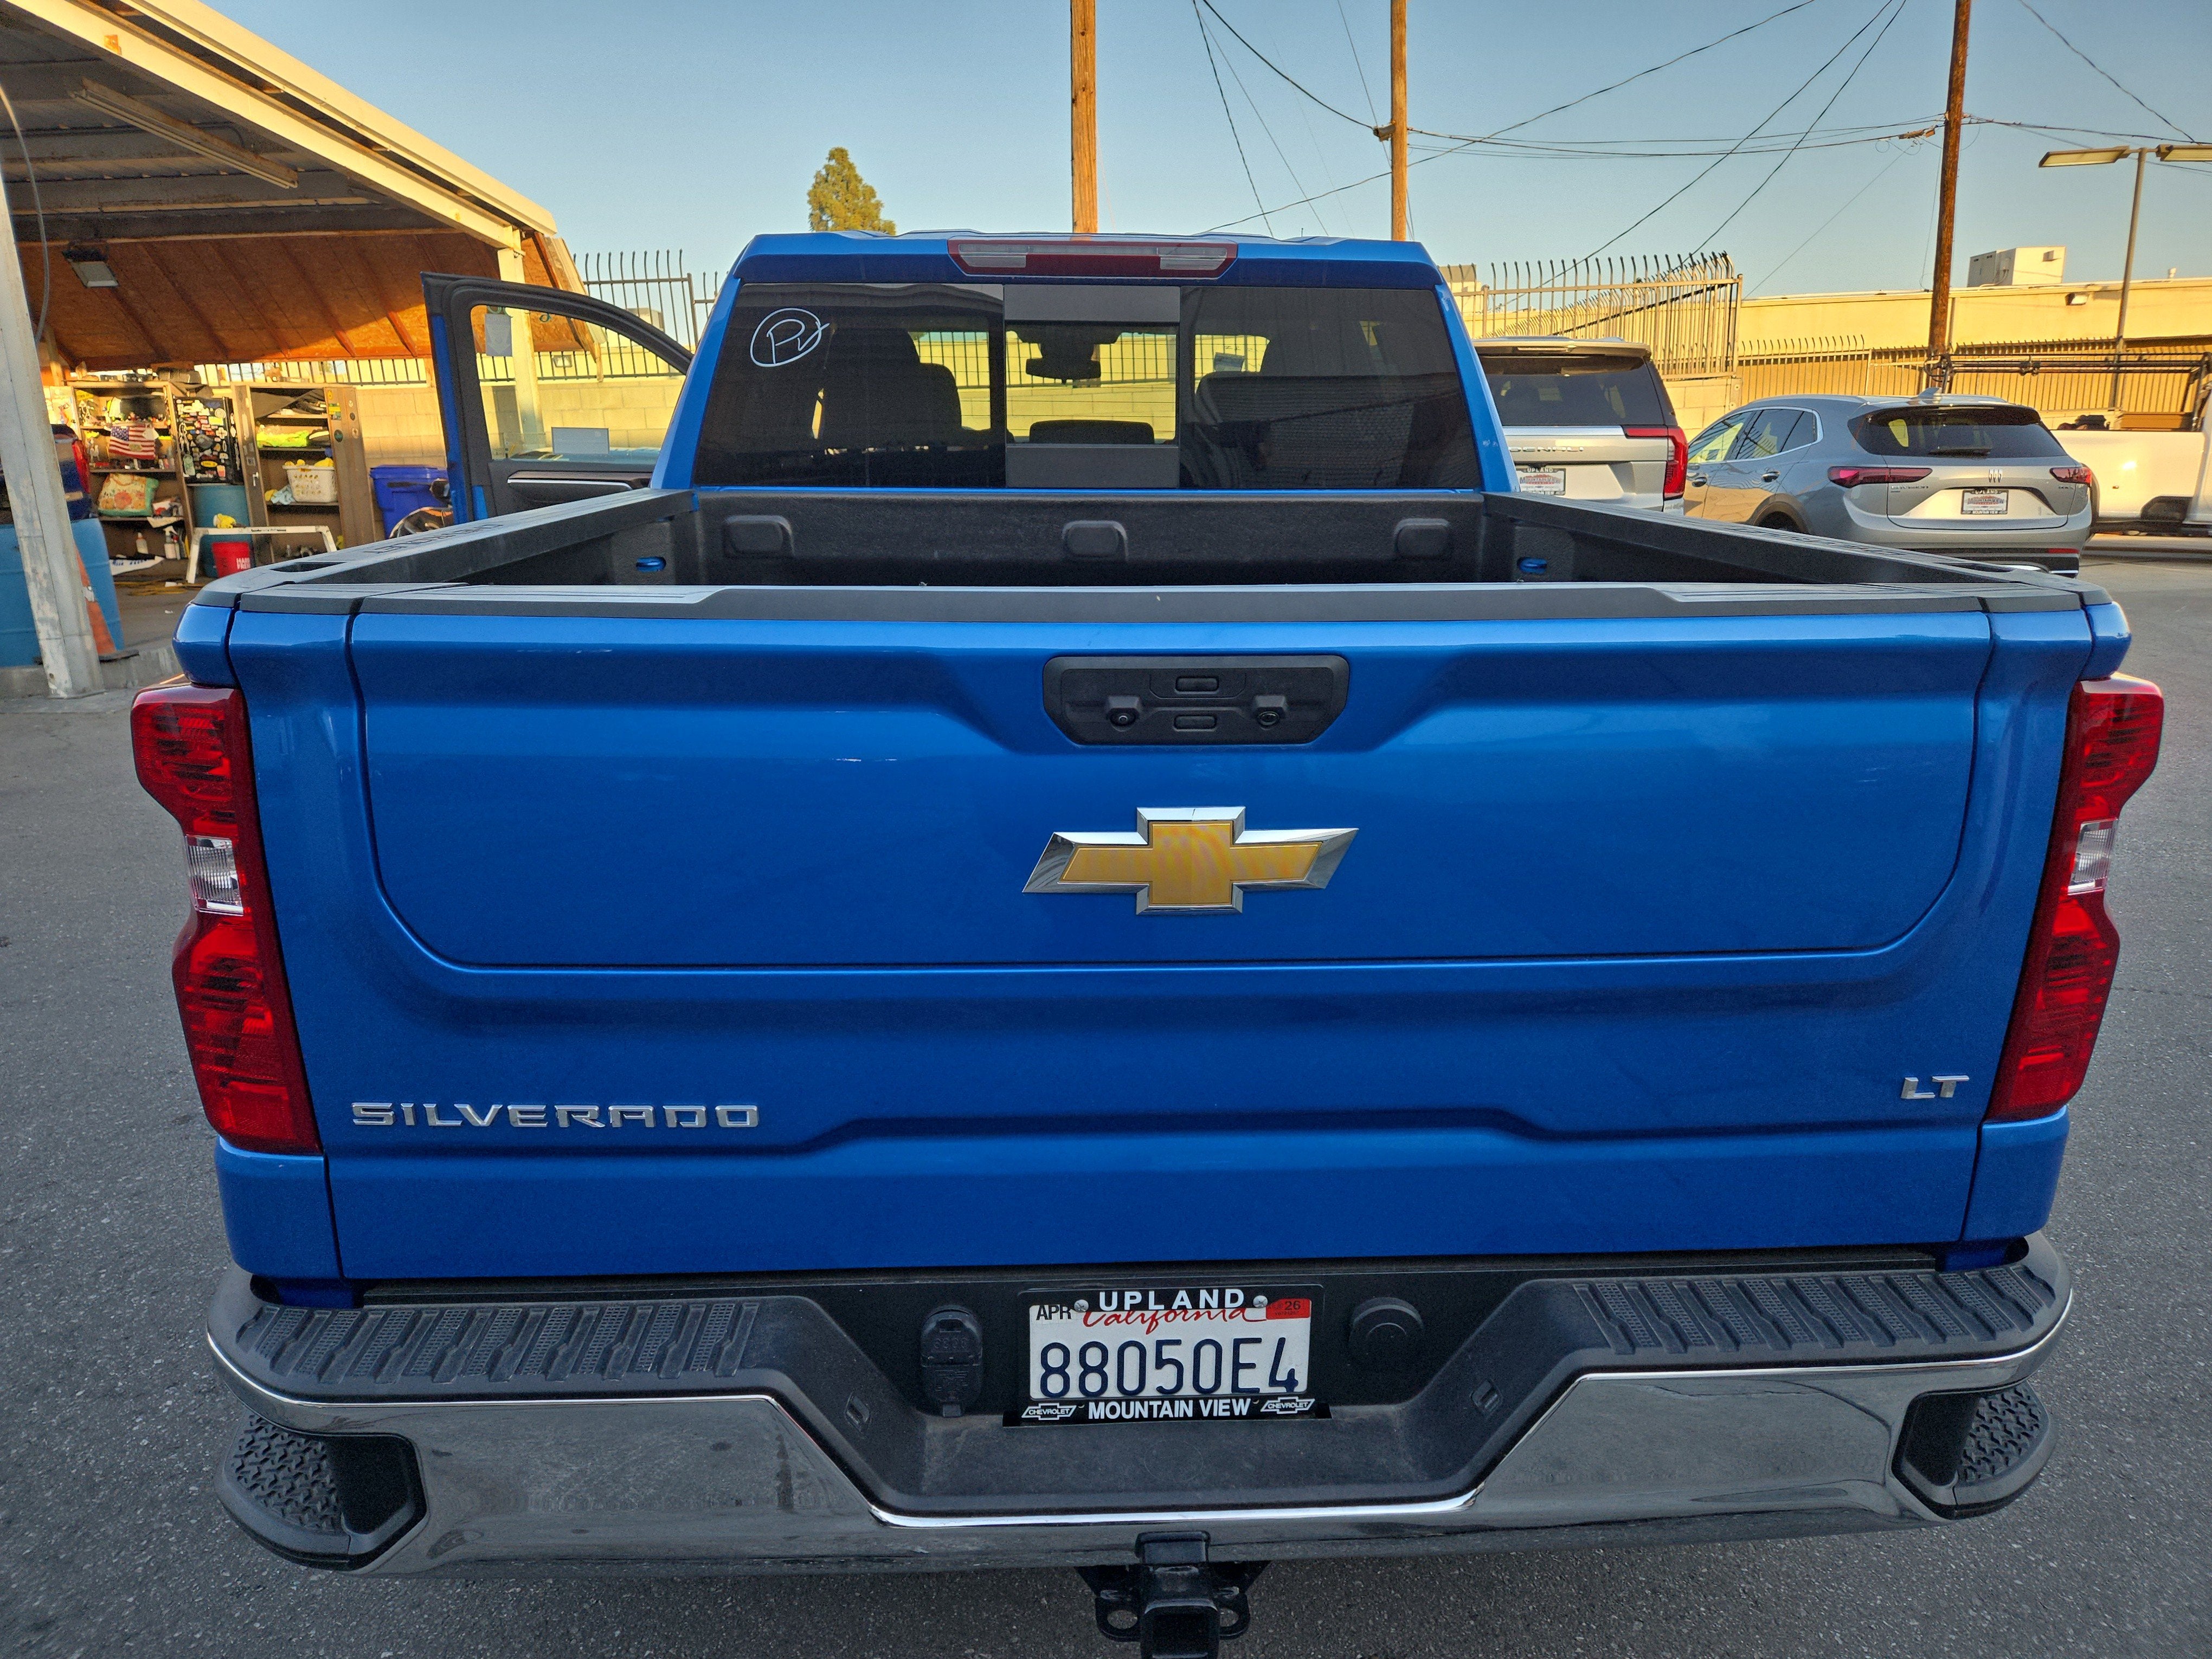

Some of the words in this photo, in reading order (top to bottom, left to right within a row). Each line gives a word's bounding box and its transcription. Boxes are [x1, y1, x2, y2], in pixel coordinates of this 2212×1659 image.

[1900, 1075, 1970, 1099] LT
[351, 1102, 760, 1128] SILVERADO
[1099, 1289, 1244, 1311] UPLAND
[1284, 1300, 1301, 1311] 26
[1036, 1304, 1071, 1321] APR
[1040, 1337, 1299, 1397] 88050E4
[1088, 1400, 1193, 1420] MOUNTAIN
[1198, 1398, 1251, 1417] VIEW
